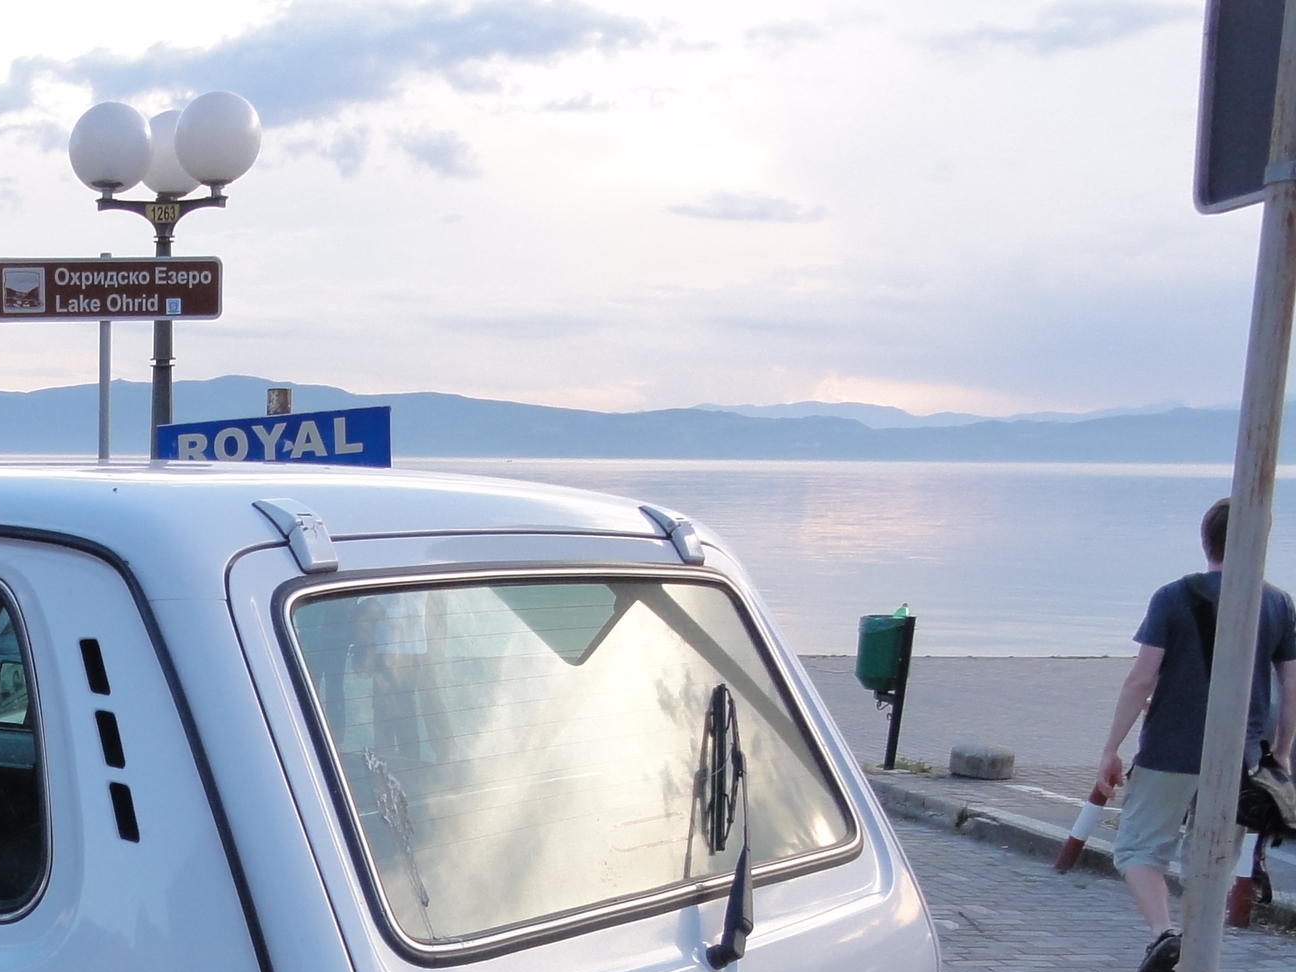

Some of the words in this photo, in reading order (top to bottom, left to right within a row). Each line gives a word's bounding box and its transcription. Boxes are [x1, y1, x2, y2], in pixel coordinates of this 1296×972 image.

[151, 206, 176, 221] 1263
[54, 267, 150, 289] Охридско
[155, 266, 212, 288] Езеро
[55, 295, 101, 312] Lake
[106, 294, 158, 312] Ohrid
[177, 417, 363, 461] ROYAL
